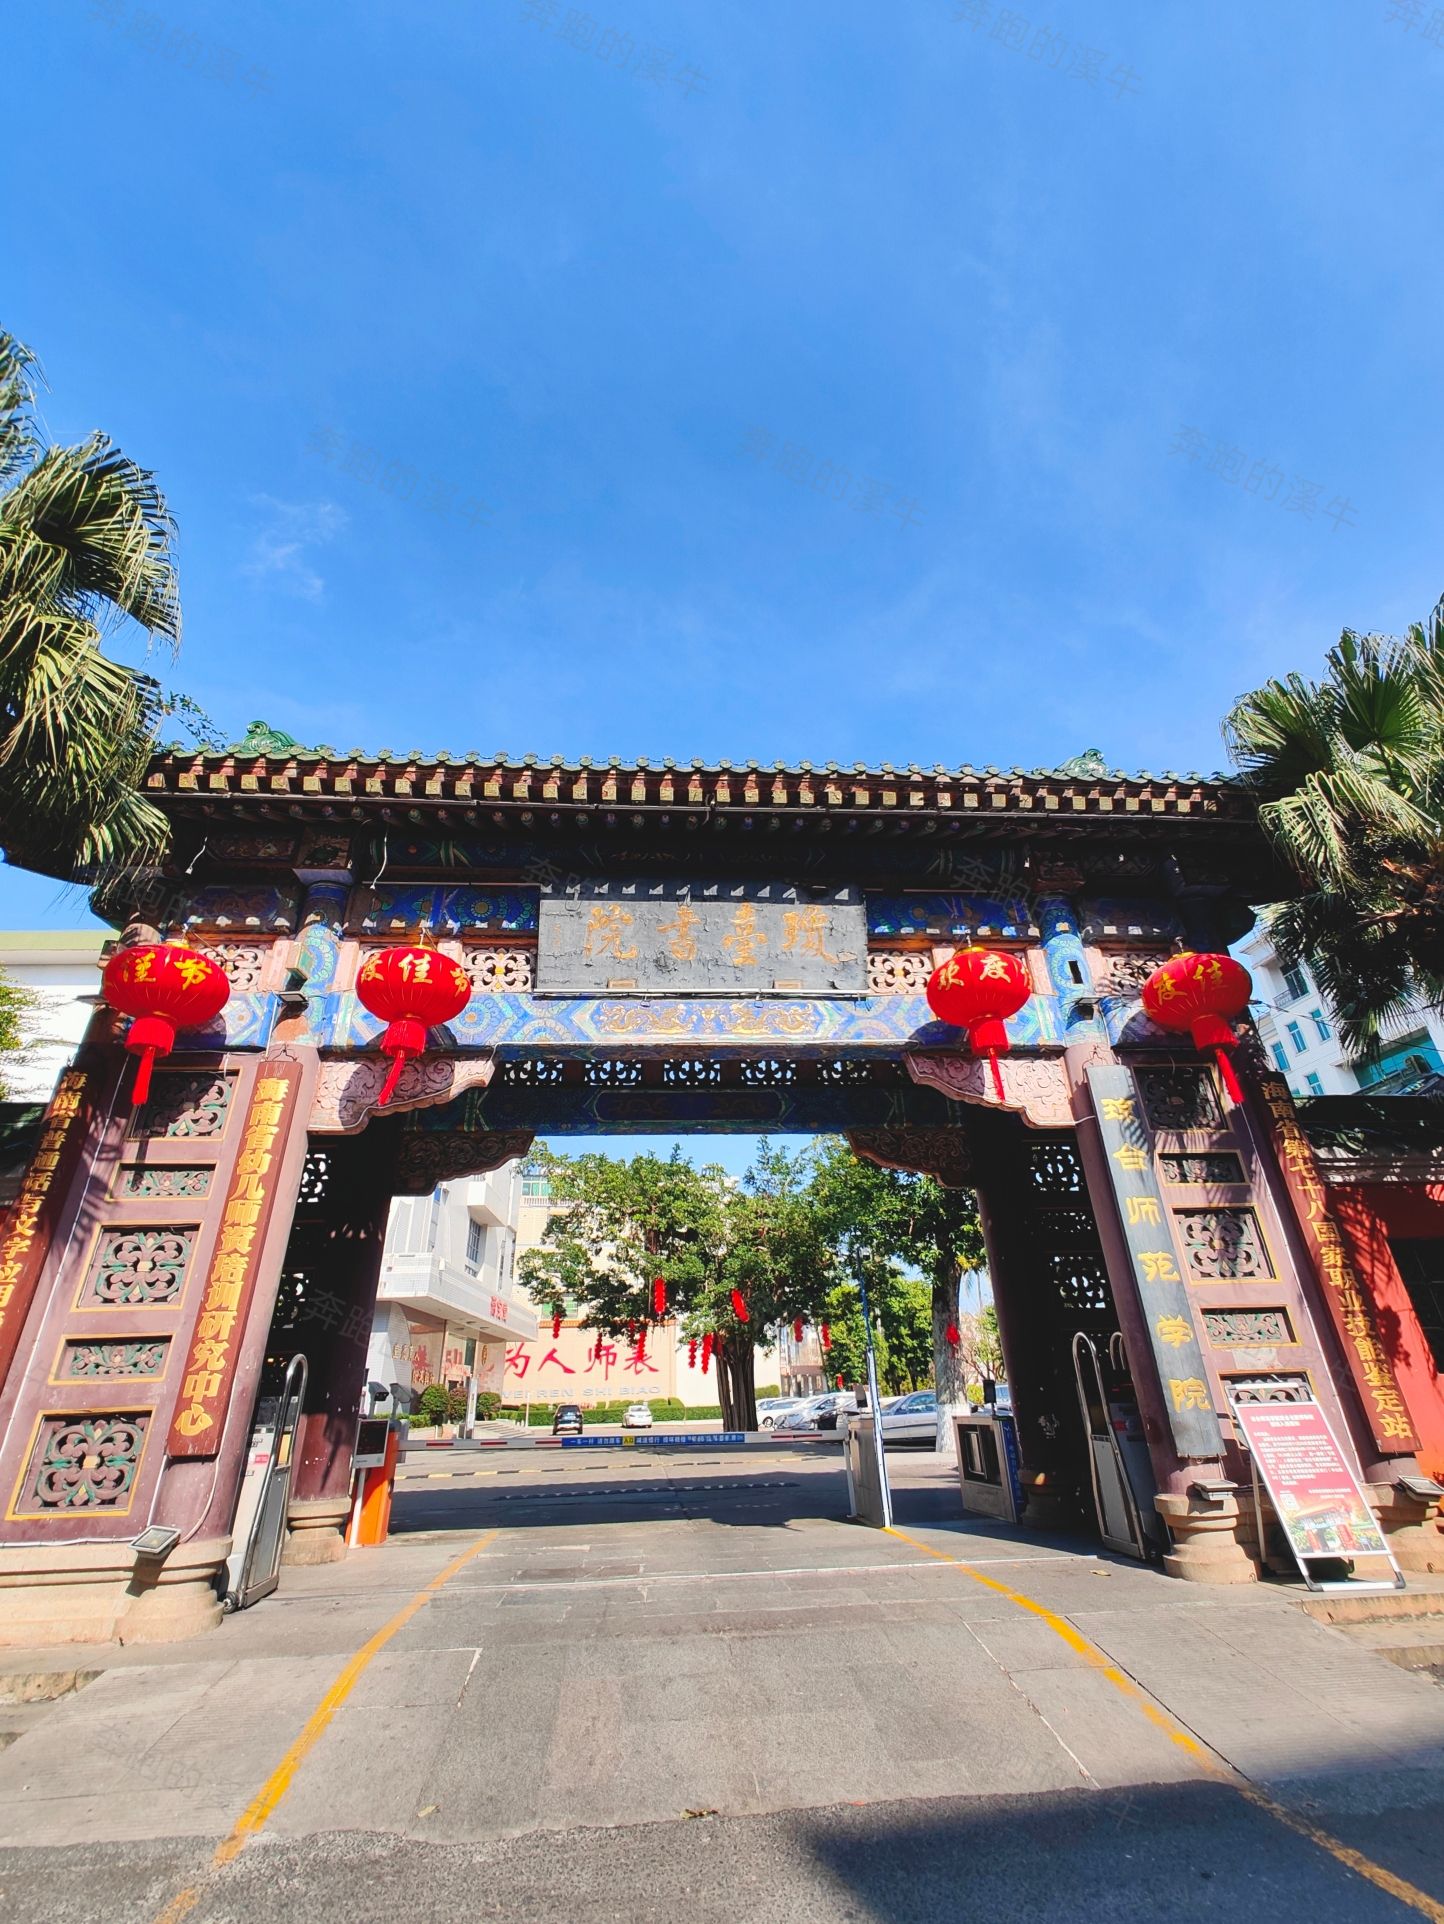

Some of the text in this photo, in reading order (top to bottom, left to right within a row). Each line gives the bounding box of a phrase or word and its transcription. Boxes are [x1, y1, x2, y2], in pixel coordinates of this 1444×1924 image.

[174, 1077, 290, 1436] 海南省幼儿师资培训研究中心
[1101, 1097, 1211, 1413] 琼台师范学院
[1261, 1081, 1413, 1439] 海南省第七十八国家职业技能鉴定站
